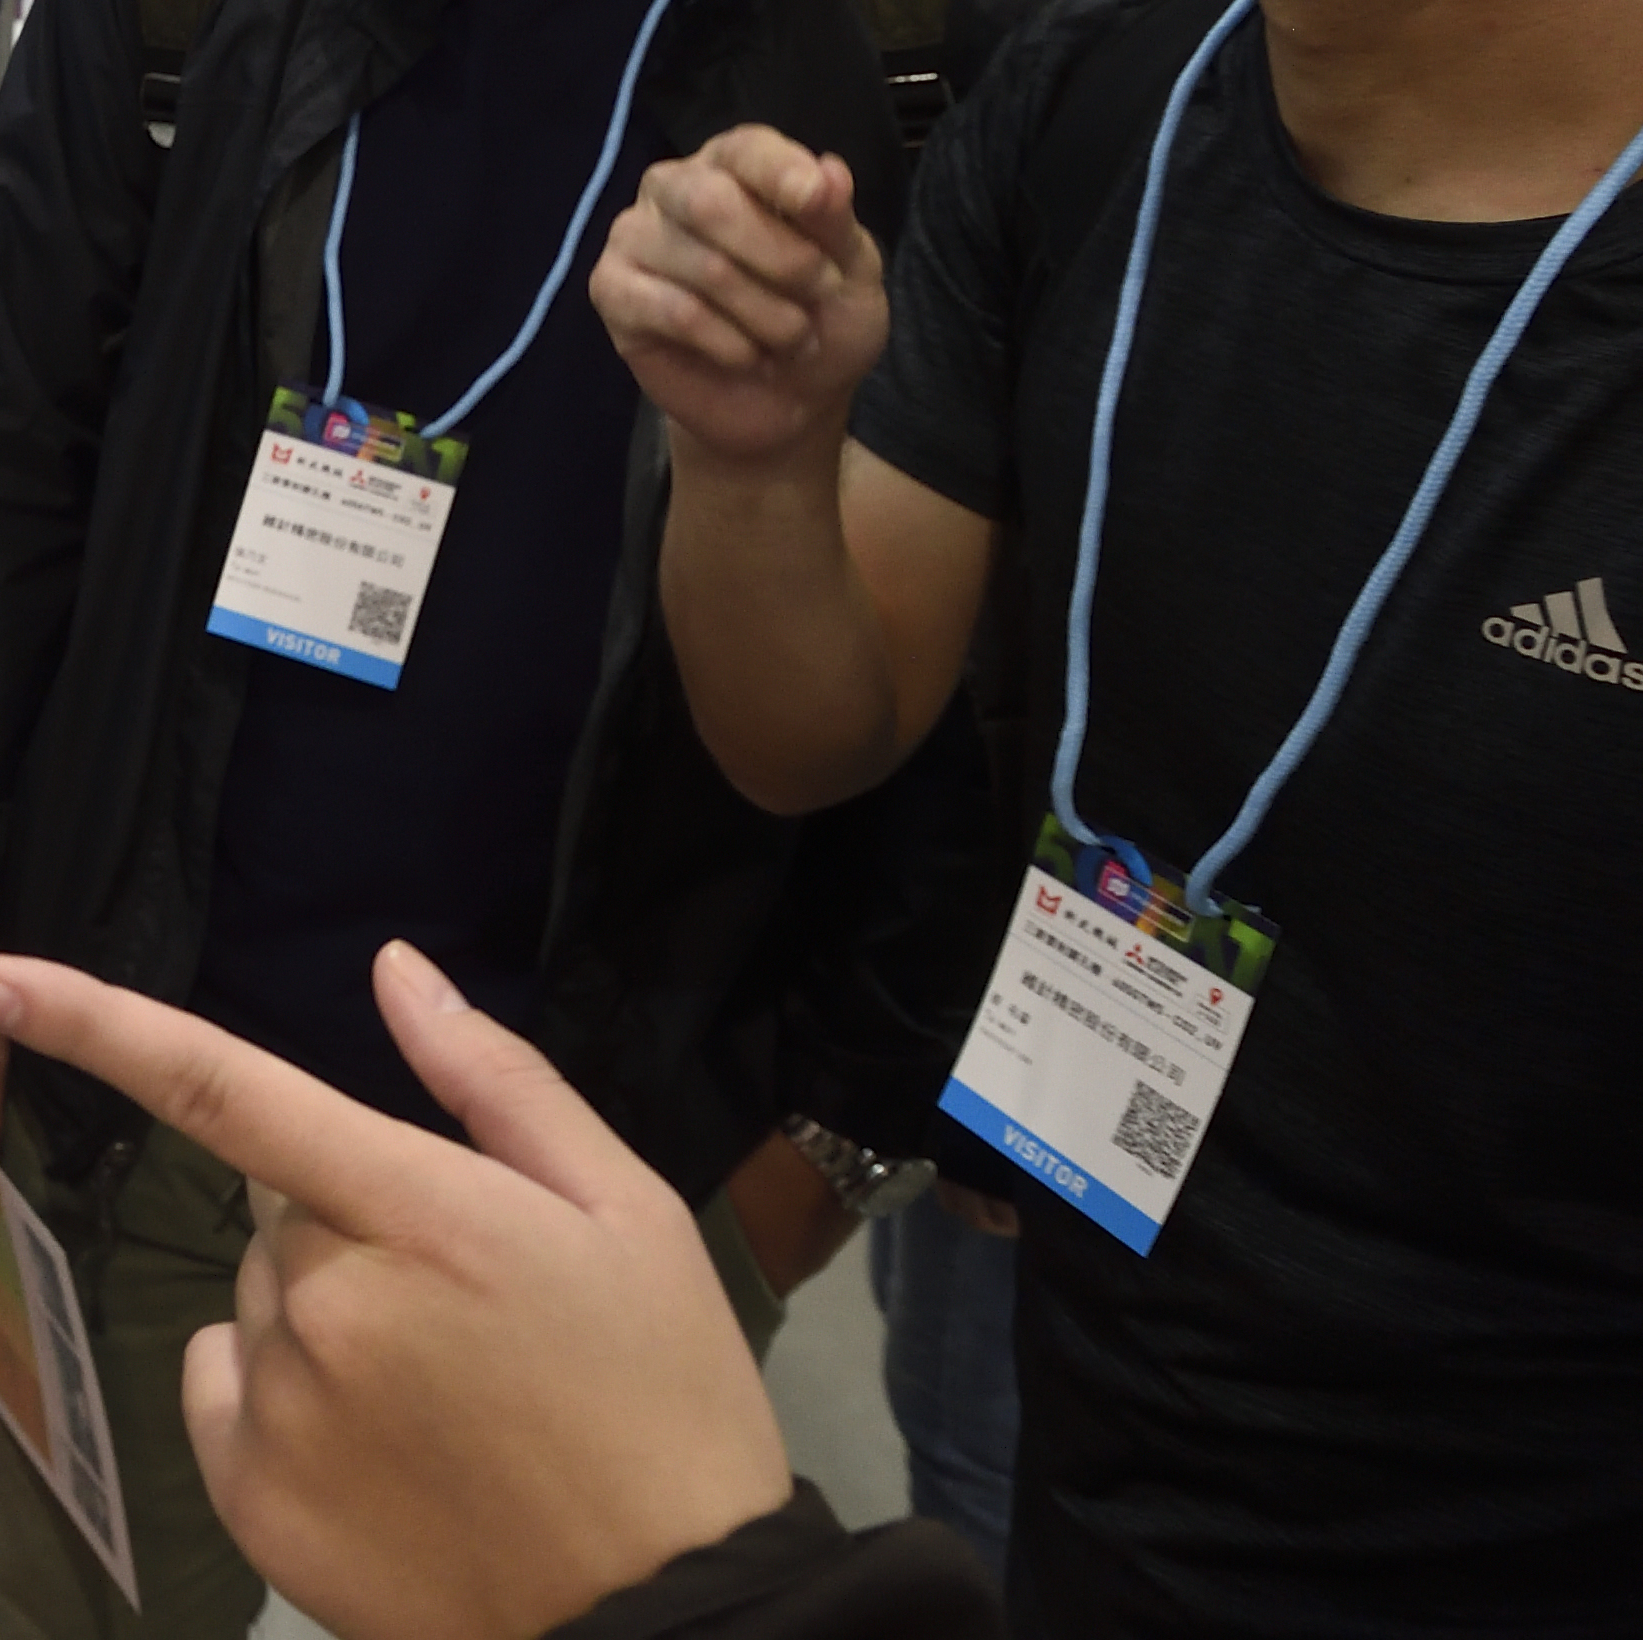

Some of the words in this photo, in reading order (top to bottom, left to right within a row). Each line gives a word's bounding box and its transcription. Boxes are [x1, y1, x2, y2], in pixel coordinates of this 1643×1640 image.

[265, 627, 342, 665] VISITOR
[1481, 616, 1643, 692] adidas
[1002, 1124, 1090, 1200] VISITOR
